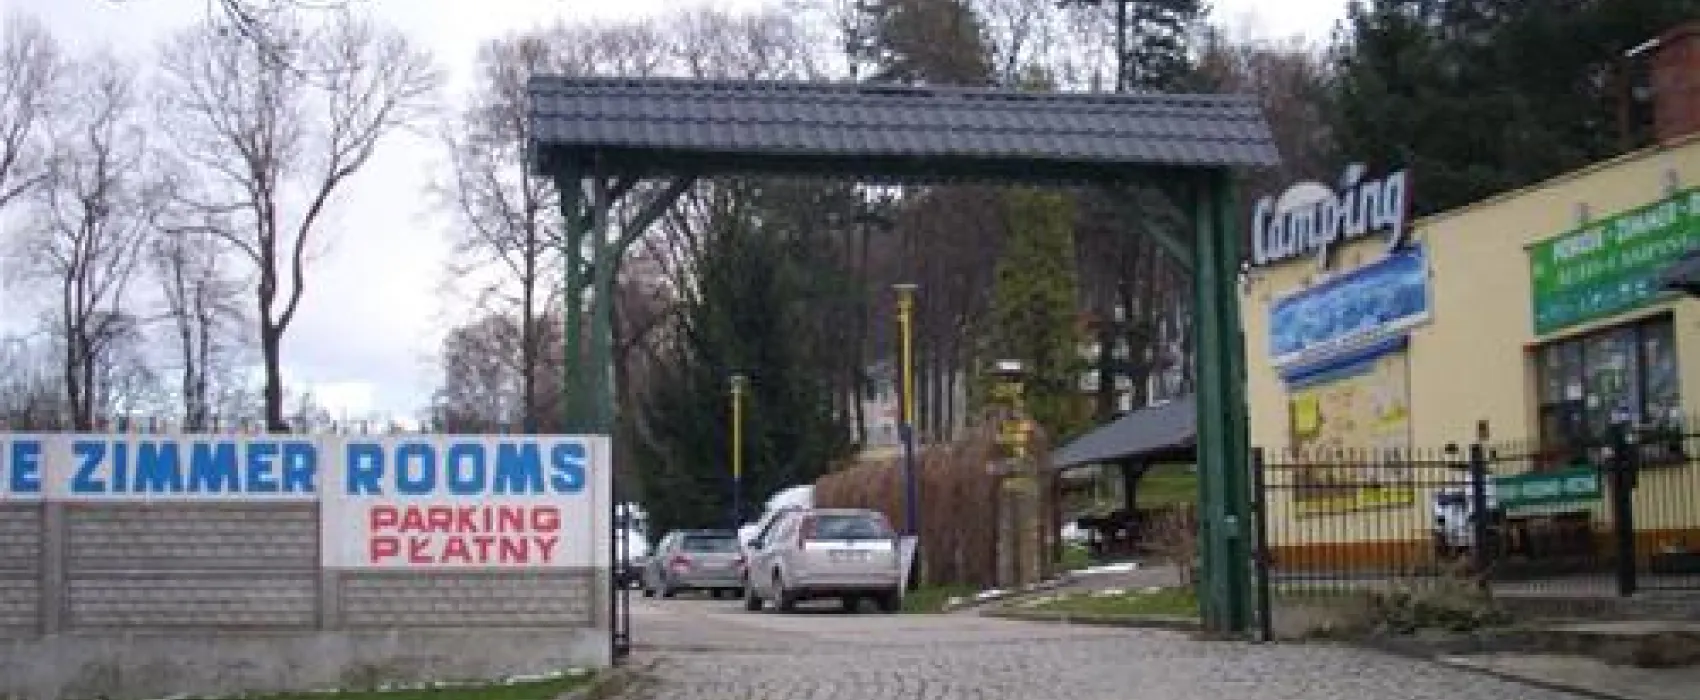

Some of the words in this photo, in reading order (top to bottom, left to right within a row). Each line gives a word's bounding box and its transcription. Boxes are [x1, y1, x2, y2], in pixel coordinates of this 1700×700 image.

[1253, 162, 1406, 268] Camping
[70, 440, 317, 494] ZIMMER
[345, 442, 587, 497] ROOMS
[369, 505, 561, 534] PARKING
[369, 536, 560, 565] PŁATNY
